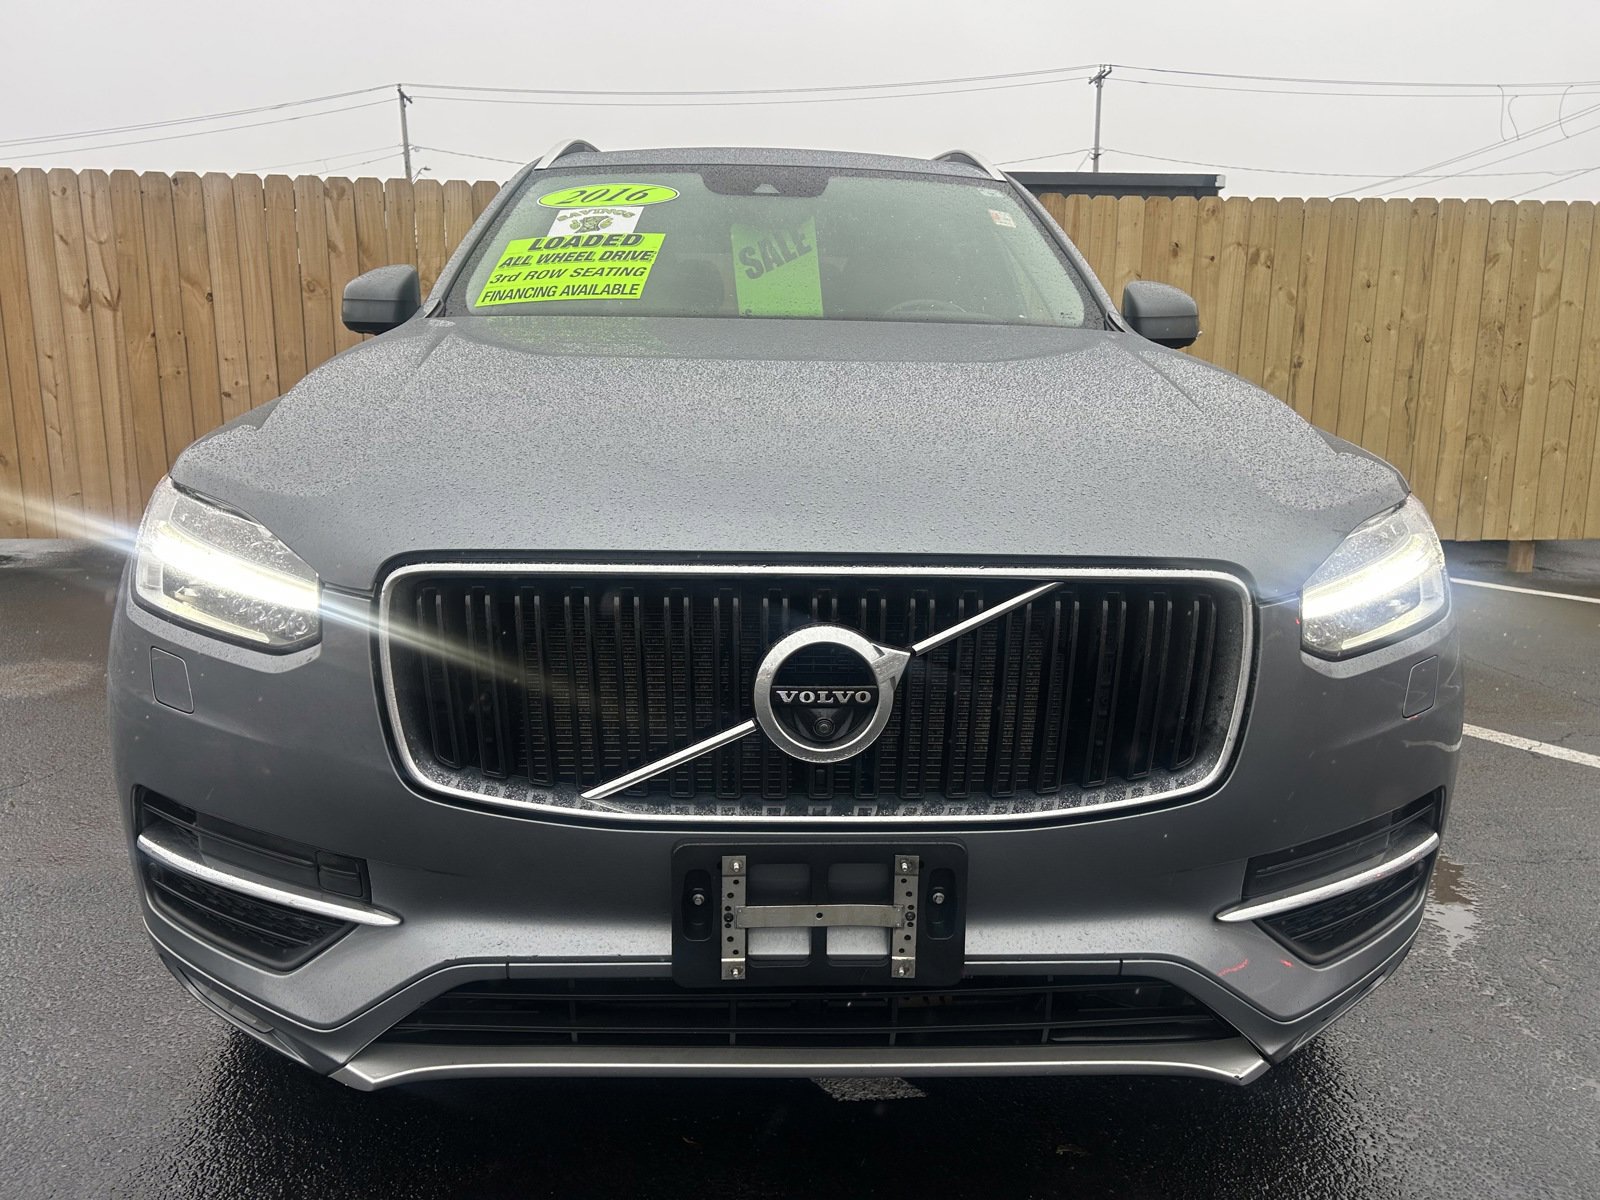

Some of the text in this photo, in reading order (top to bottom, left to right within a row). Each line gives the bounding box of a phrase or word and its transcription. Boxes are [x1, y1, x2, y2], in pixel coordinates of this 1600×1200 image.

[555, 187, 658, 205] 2016
[528, 234, 644, 252] LOADED
[738, 224, 813, 280] SALE
[498, 250, 657, 269] ALL WHEEL DRIVE
[490, 266, 647, 284] 3rd ROW SEATING
[481, 283, 641, 303] FINANCING AVAILABLE
[776, 690, 872, 704] VOLVO
